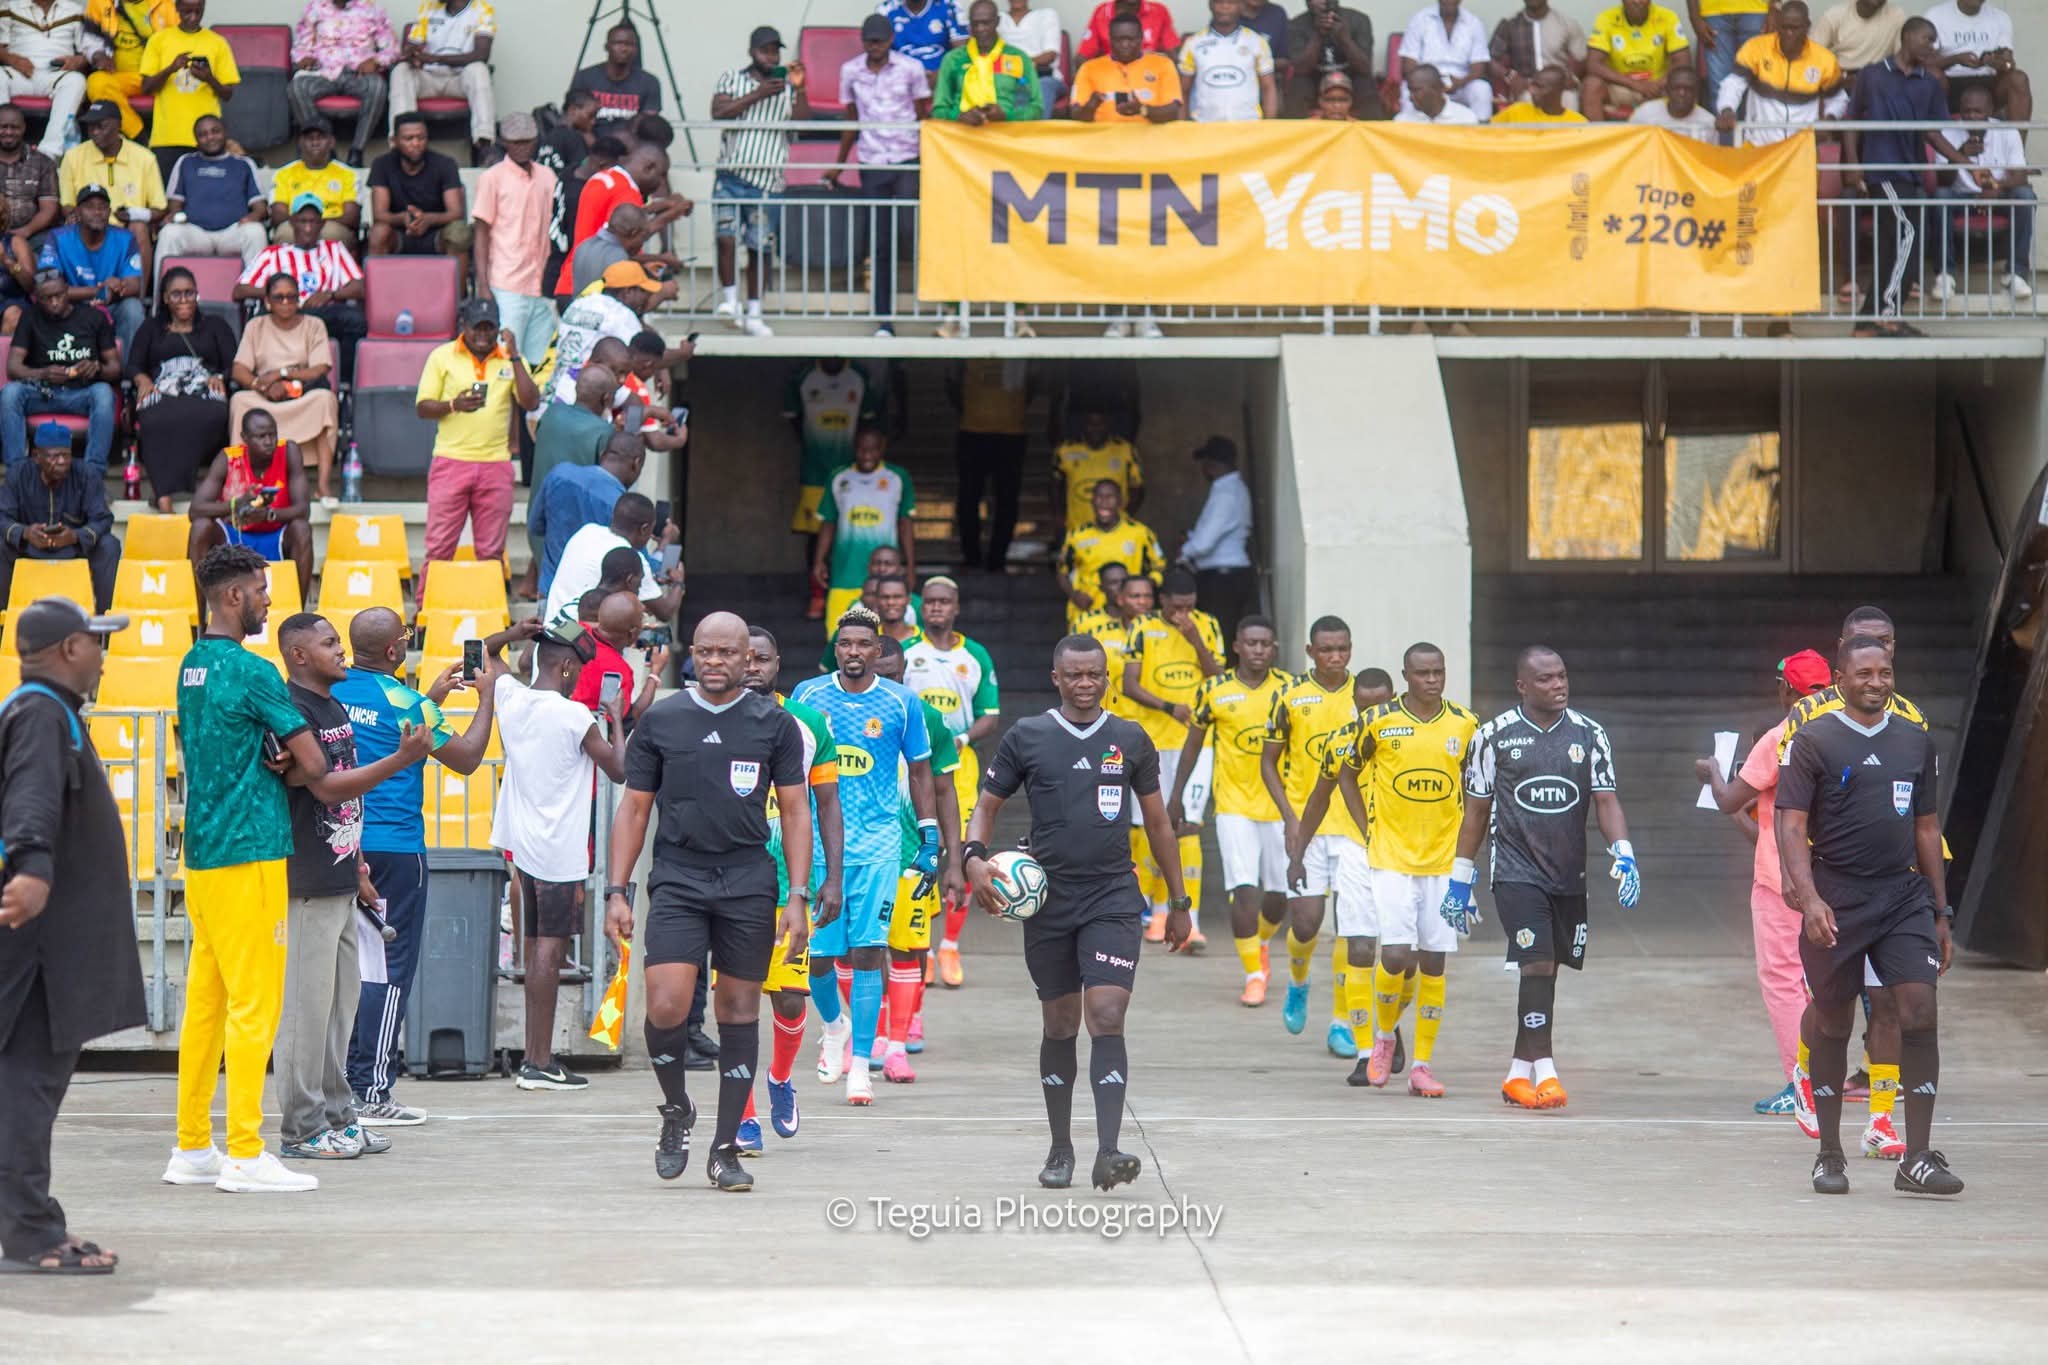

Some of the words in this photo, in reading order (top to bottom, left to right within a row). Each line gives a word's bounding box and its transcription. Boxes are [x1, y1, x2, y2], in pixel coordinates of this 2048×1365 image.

[1953, 31, 1990, 43] POLO
[1635, 184, 1696, 210] Tape
[991, 171, 1219, 247] MTN
[1240, 172, 1520, 256] YaMo
[183, 667, 208, 687] COACH
[1164, 671, 1194, 681] MTN
[924, 694, 958, 708] MTN
[1379, 728, 1414, 738] CANAL+
[1497, 736, 1536, 750] CANAL+
[734, 763, 757, 773] FIFA
[1101, 788, 1120, 797] FIFA
[1407, 779, 1443, 793] MTN
[1896, 783, 1912, 793] FIFA
[1530, 787, 1567, 802] MTN
[1573, 922, 1588, 946] 16
[1109, 956, 1135, 970] sport
